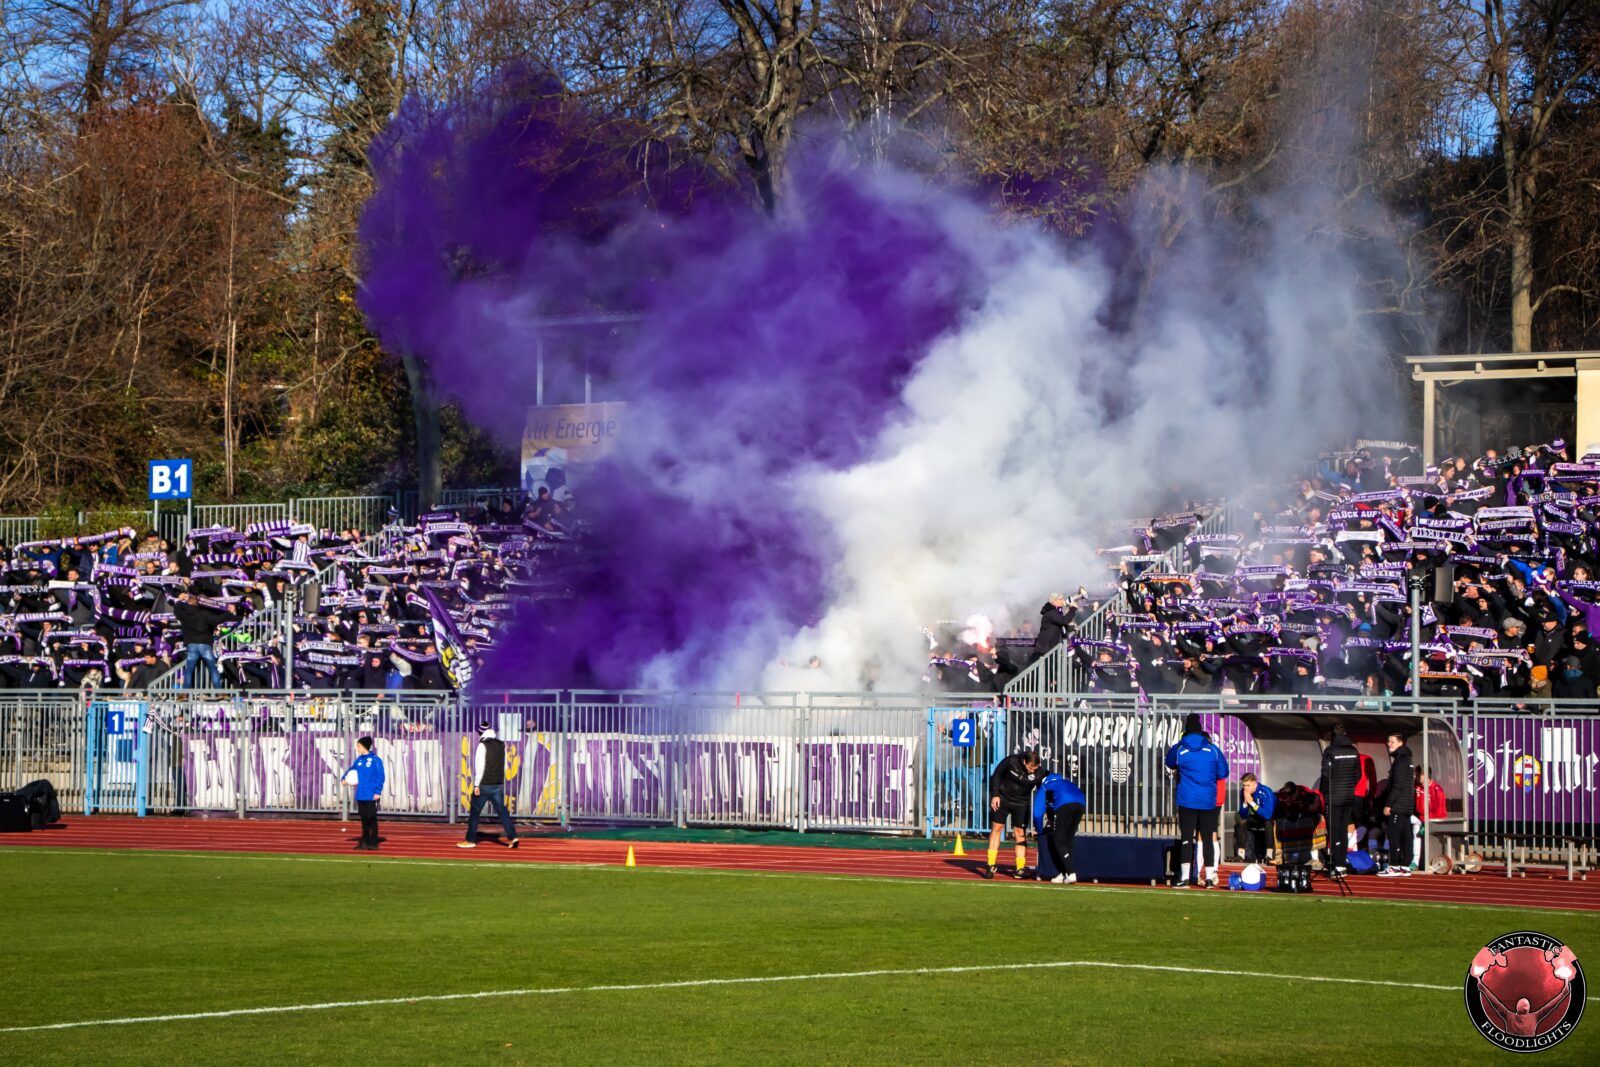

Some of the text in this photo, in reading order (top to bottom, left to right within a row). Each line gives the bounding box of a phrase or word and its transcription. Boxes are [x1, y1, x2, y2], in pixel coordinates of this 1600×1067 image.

[555, 417, 617, 444] Energie
[1411, 489, 1422, 497] FC
[1331, 510, 1359, 520] GLÜCK
[1411, 527, 1447, 540] WISMUT
[112, 713, 120, 732] 1
[958, 721, 970, 743] 2
[314, 736, 447, 815] SND
